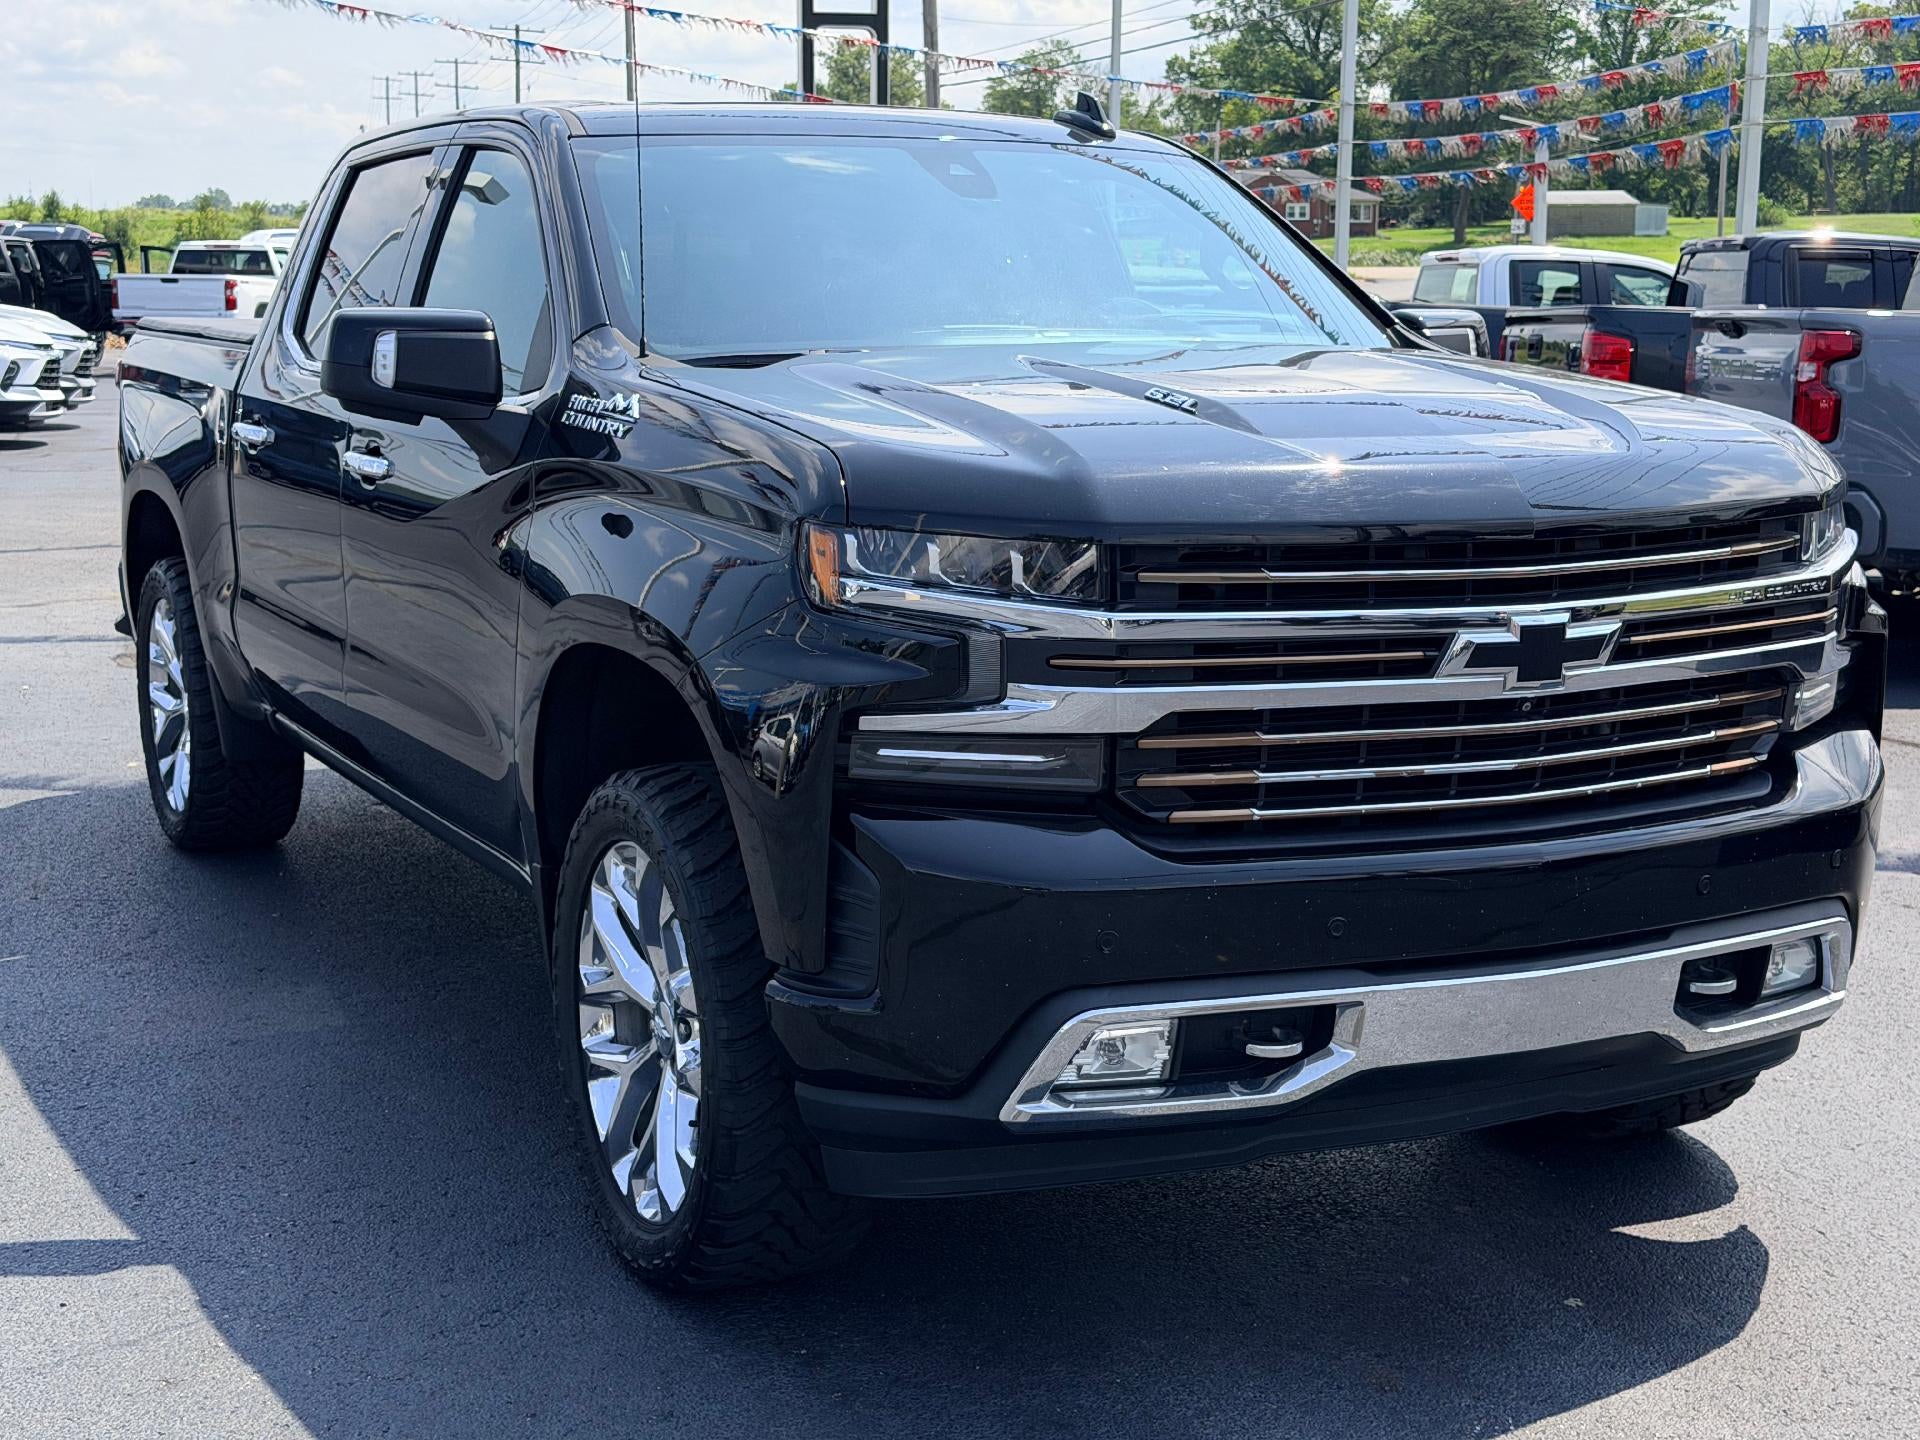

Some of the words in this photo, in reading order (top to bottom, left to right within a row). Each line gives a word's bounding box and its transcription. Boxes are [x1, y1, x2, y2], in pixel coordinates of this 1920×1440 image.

[561, 410, 633, 438] COUNTRY
[1728, 587, 1766, 603] HIGH
[1766, 580, 1827, 599] COUNTRY
